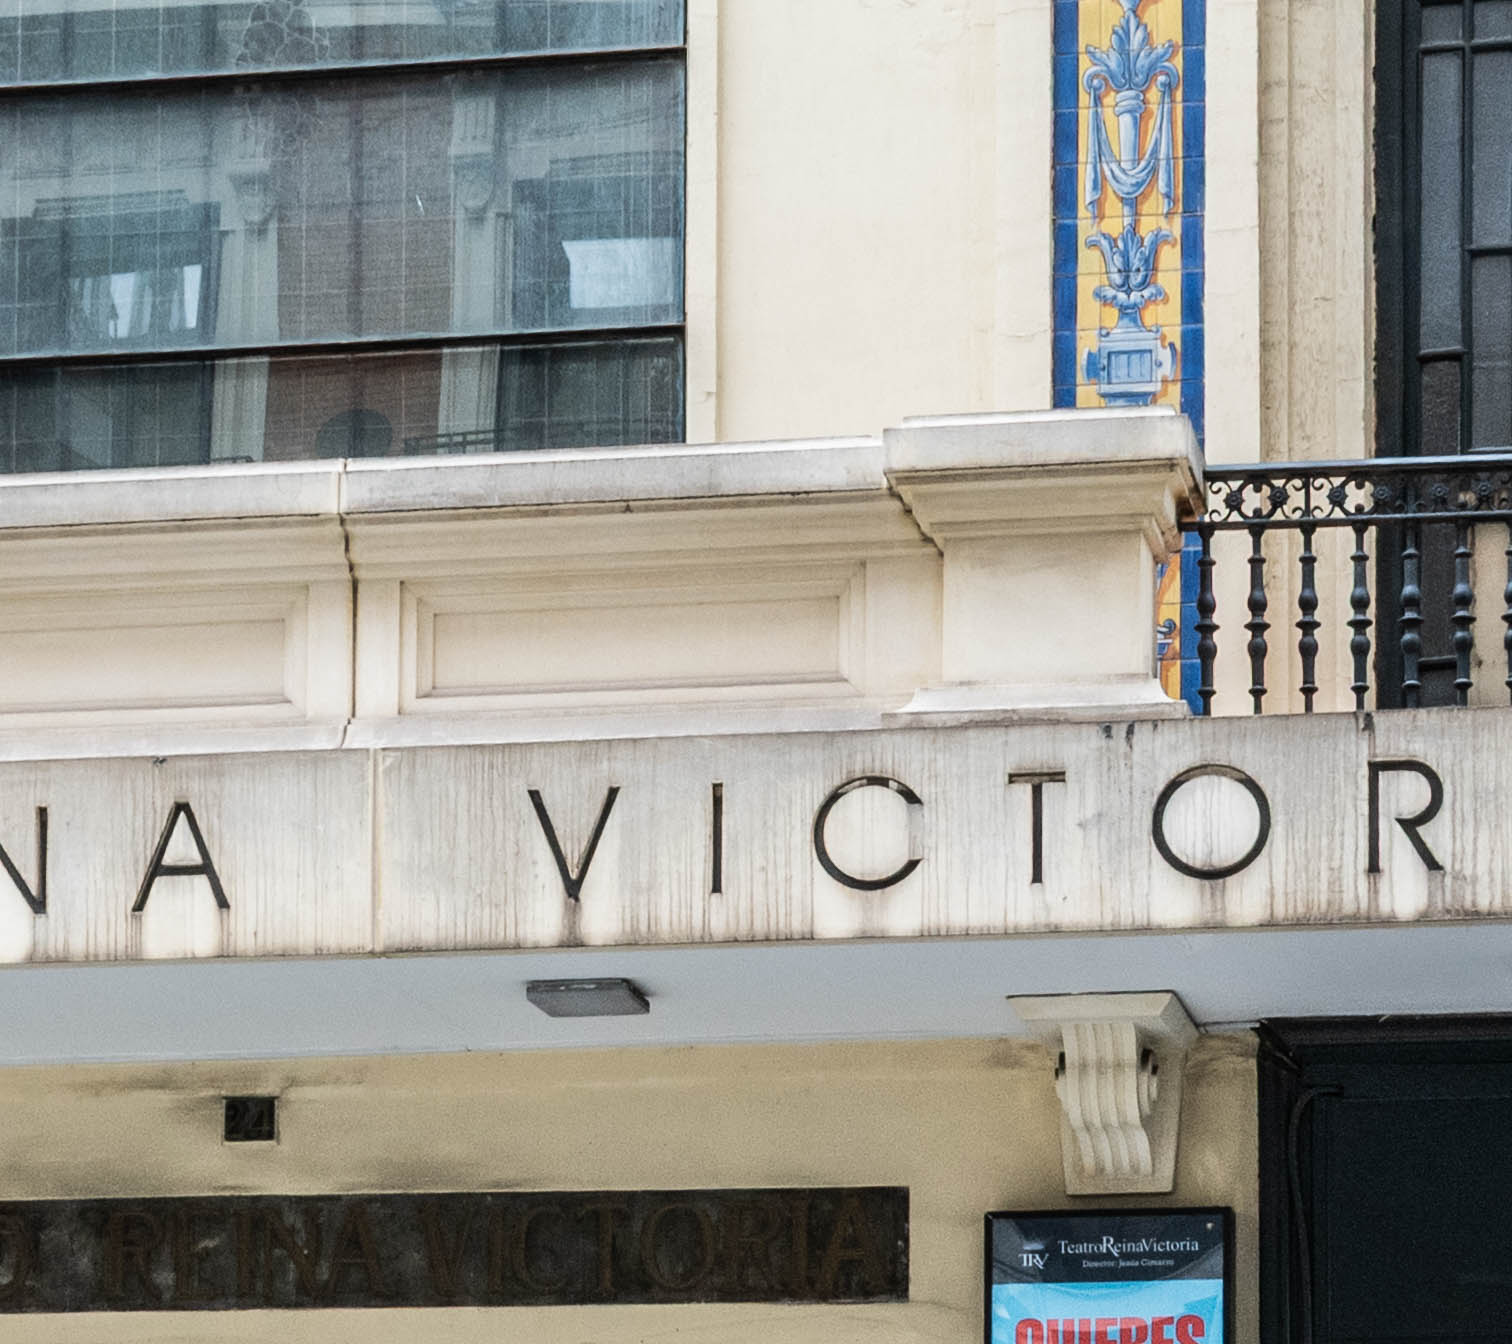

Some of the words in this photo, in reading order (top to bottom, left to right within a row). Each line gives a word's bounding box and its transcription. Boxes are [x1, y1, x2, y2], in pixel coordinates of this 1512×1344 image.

[104, 1206, 381, 1304] REINA
[415, 1191, 890, 1299] VICTORIA
[1057, 1236, 1199, 1256] TeatroReinaVictoria
